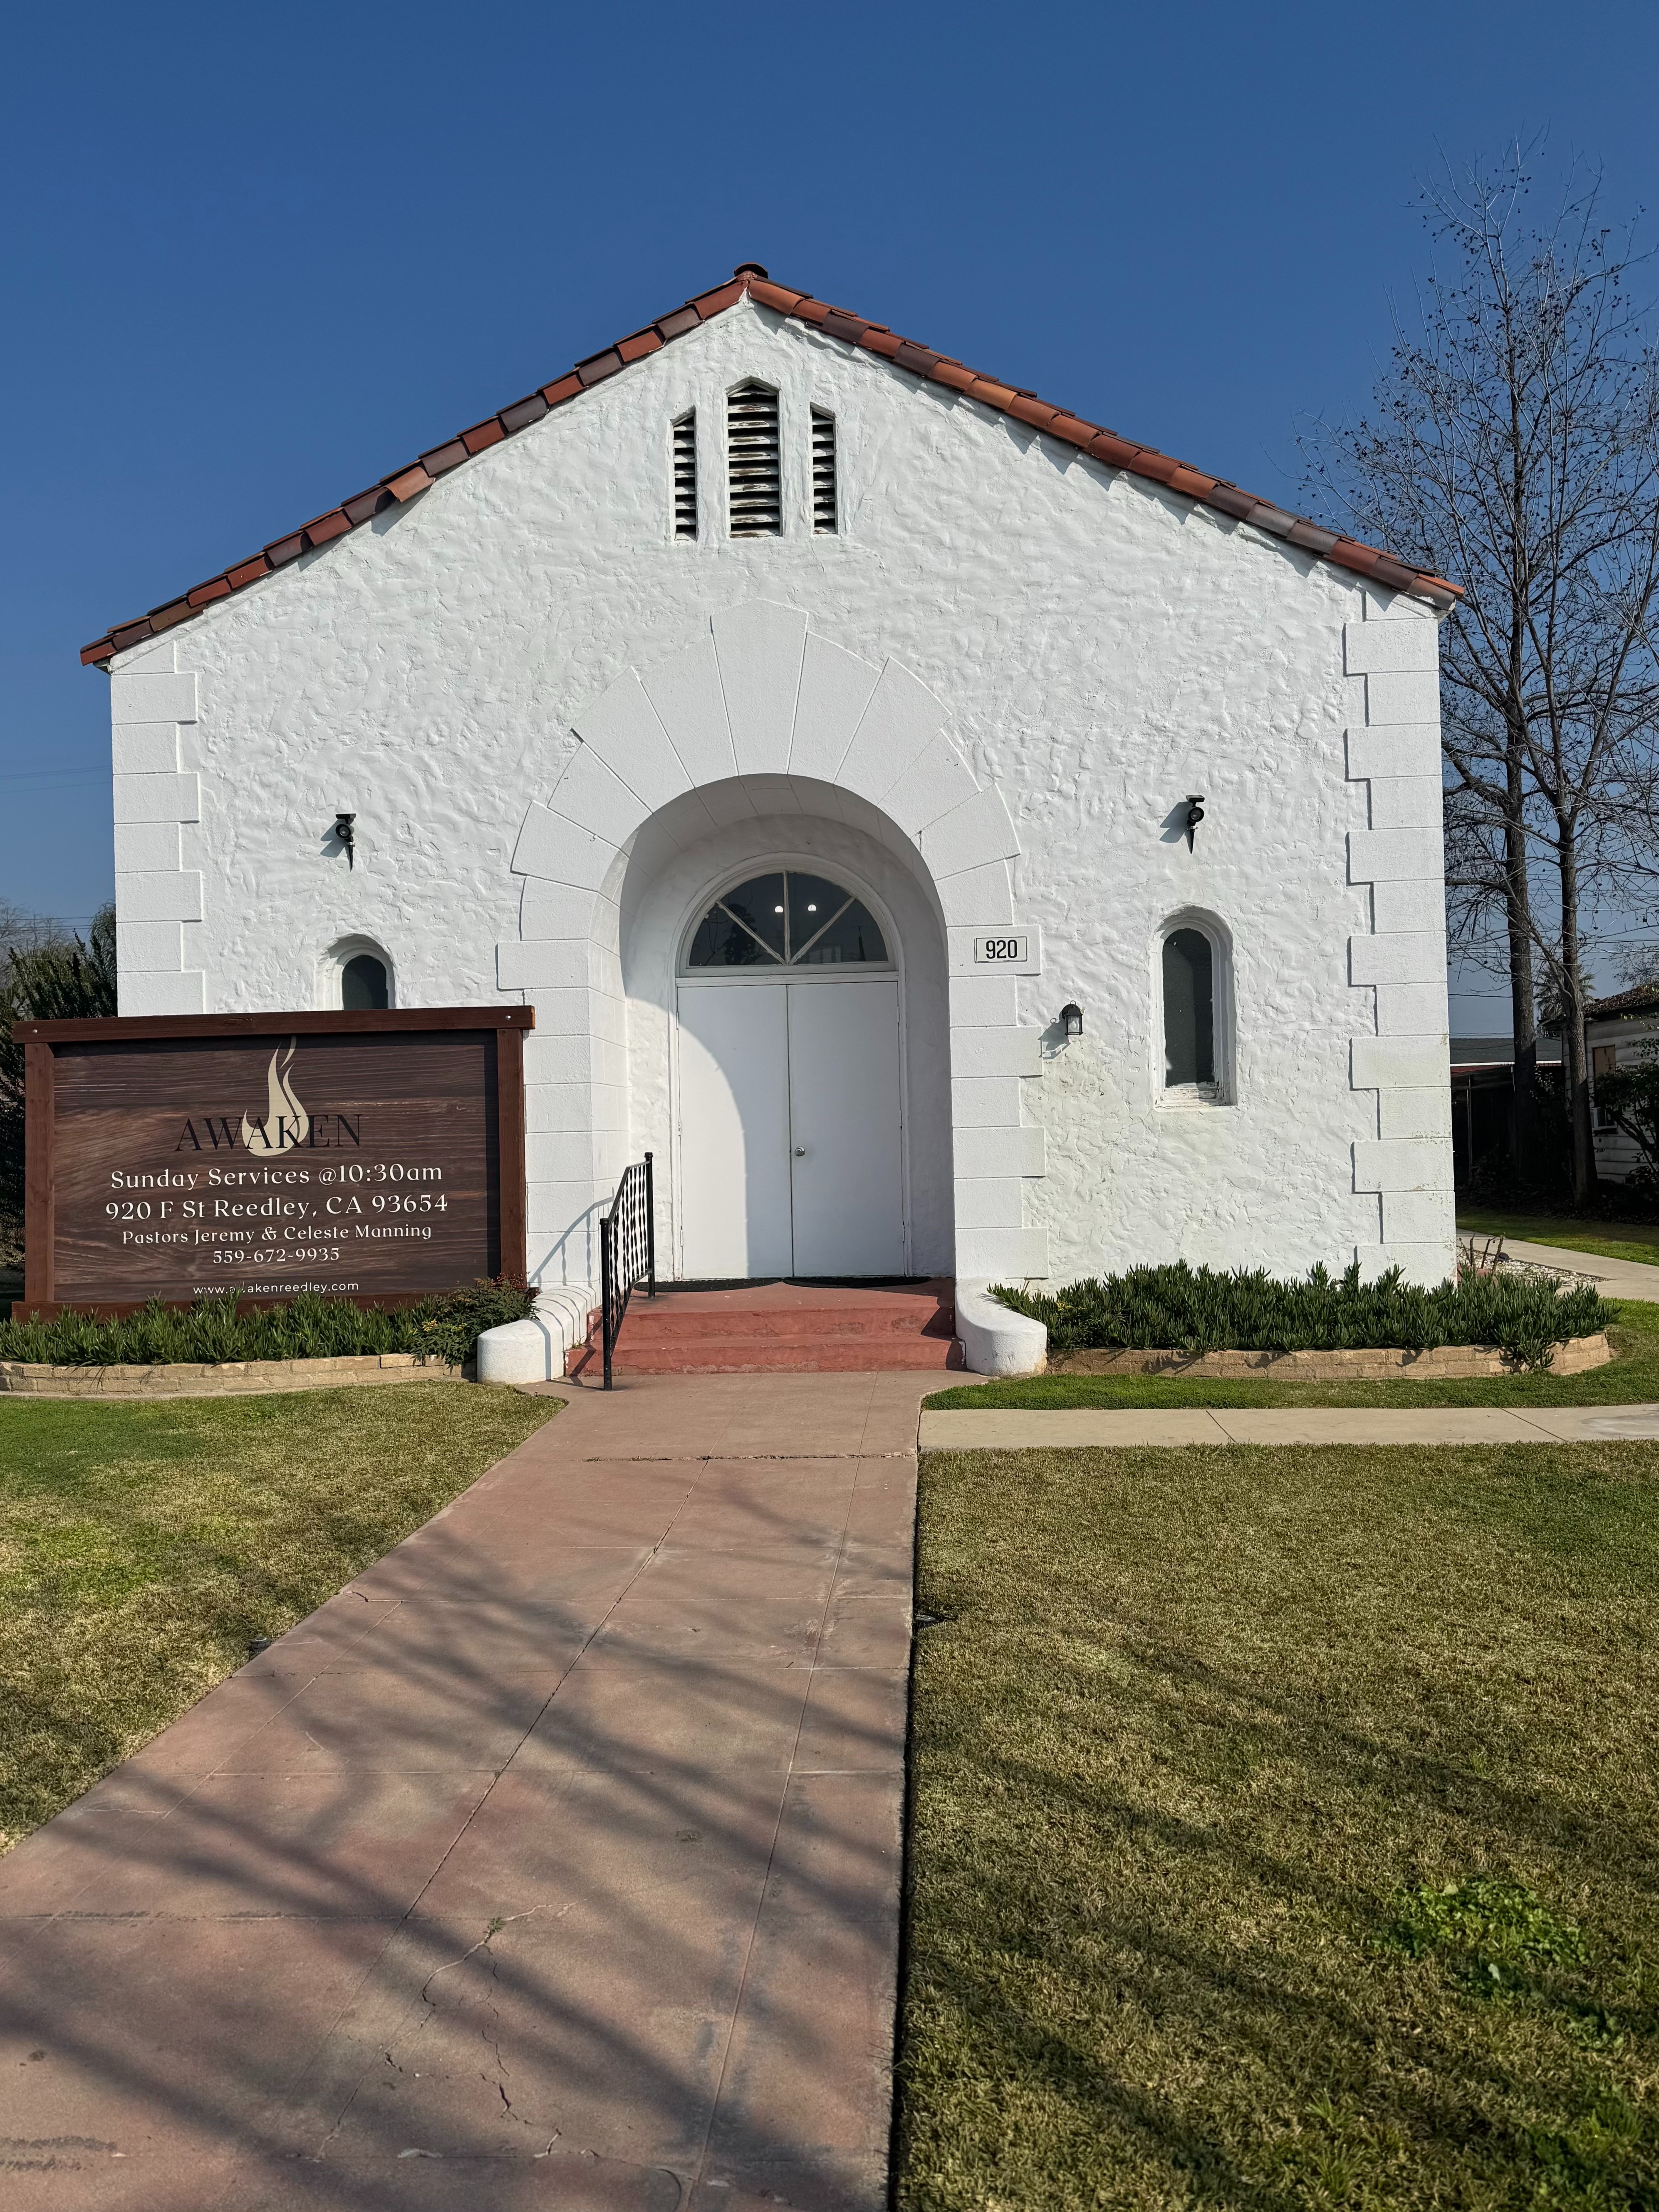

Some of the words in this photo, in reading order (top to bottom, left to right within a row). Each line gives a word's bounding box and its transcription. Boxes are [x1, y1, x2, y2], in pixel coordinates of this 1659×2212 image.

[986, 940, 1017, 959] 920
[175, 1114, 362, 1151] AWAKEN
[111, 1168, 199, 1191] Sunday
[208, 1167, 310, 1186] Services
[319, 1163, 442, 1185] @10:30am
[105, 1202, 151, 1220] 920
[160, 1201, 174, 1219] F
[182, 1200, 206, 1218] St
[214, 1197, 317, 1219] Reedley,
[326, 1195, 363, 1215] CA
[371, 1193, 448, 1213] 93654
[122, 1231, 188, 1244] Pastors
[195, 1229, 255, 1245] Jeremy
[261, 1227, 277, 1241] &
[284, 1225, 349, 1240] Celeste
[355, 1224, 431, 1240] Manning
[213, 1247, 340, 1264] 559-672-9935
[193, 1281, 359, 1294] www.aakenreedley.com
